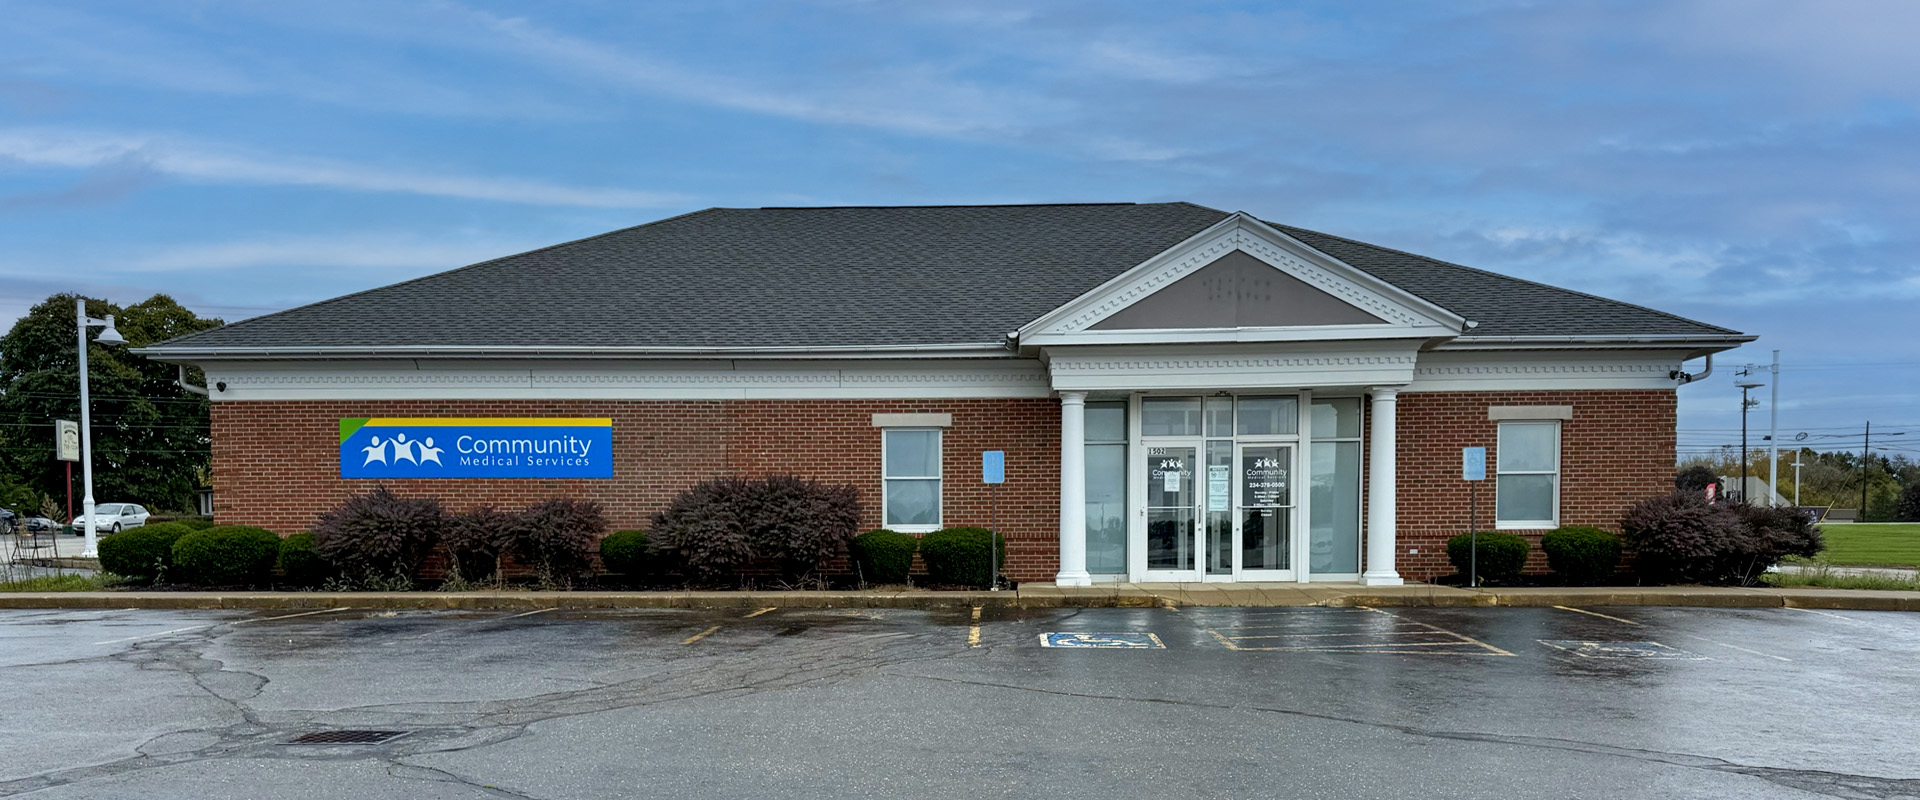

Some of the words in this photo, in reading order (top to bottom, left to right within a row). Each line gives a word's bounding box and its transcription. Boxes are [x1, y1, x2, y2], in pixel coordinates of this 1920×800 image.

[456, 435, 592, 458] Community
[1148, 447, 1165, 455] 1502
[459, 455, 519, 466] Medical
[527, 455, 590, 466] Services
[1246, 469, 1288, 477] Community
